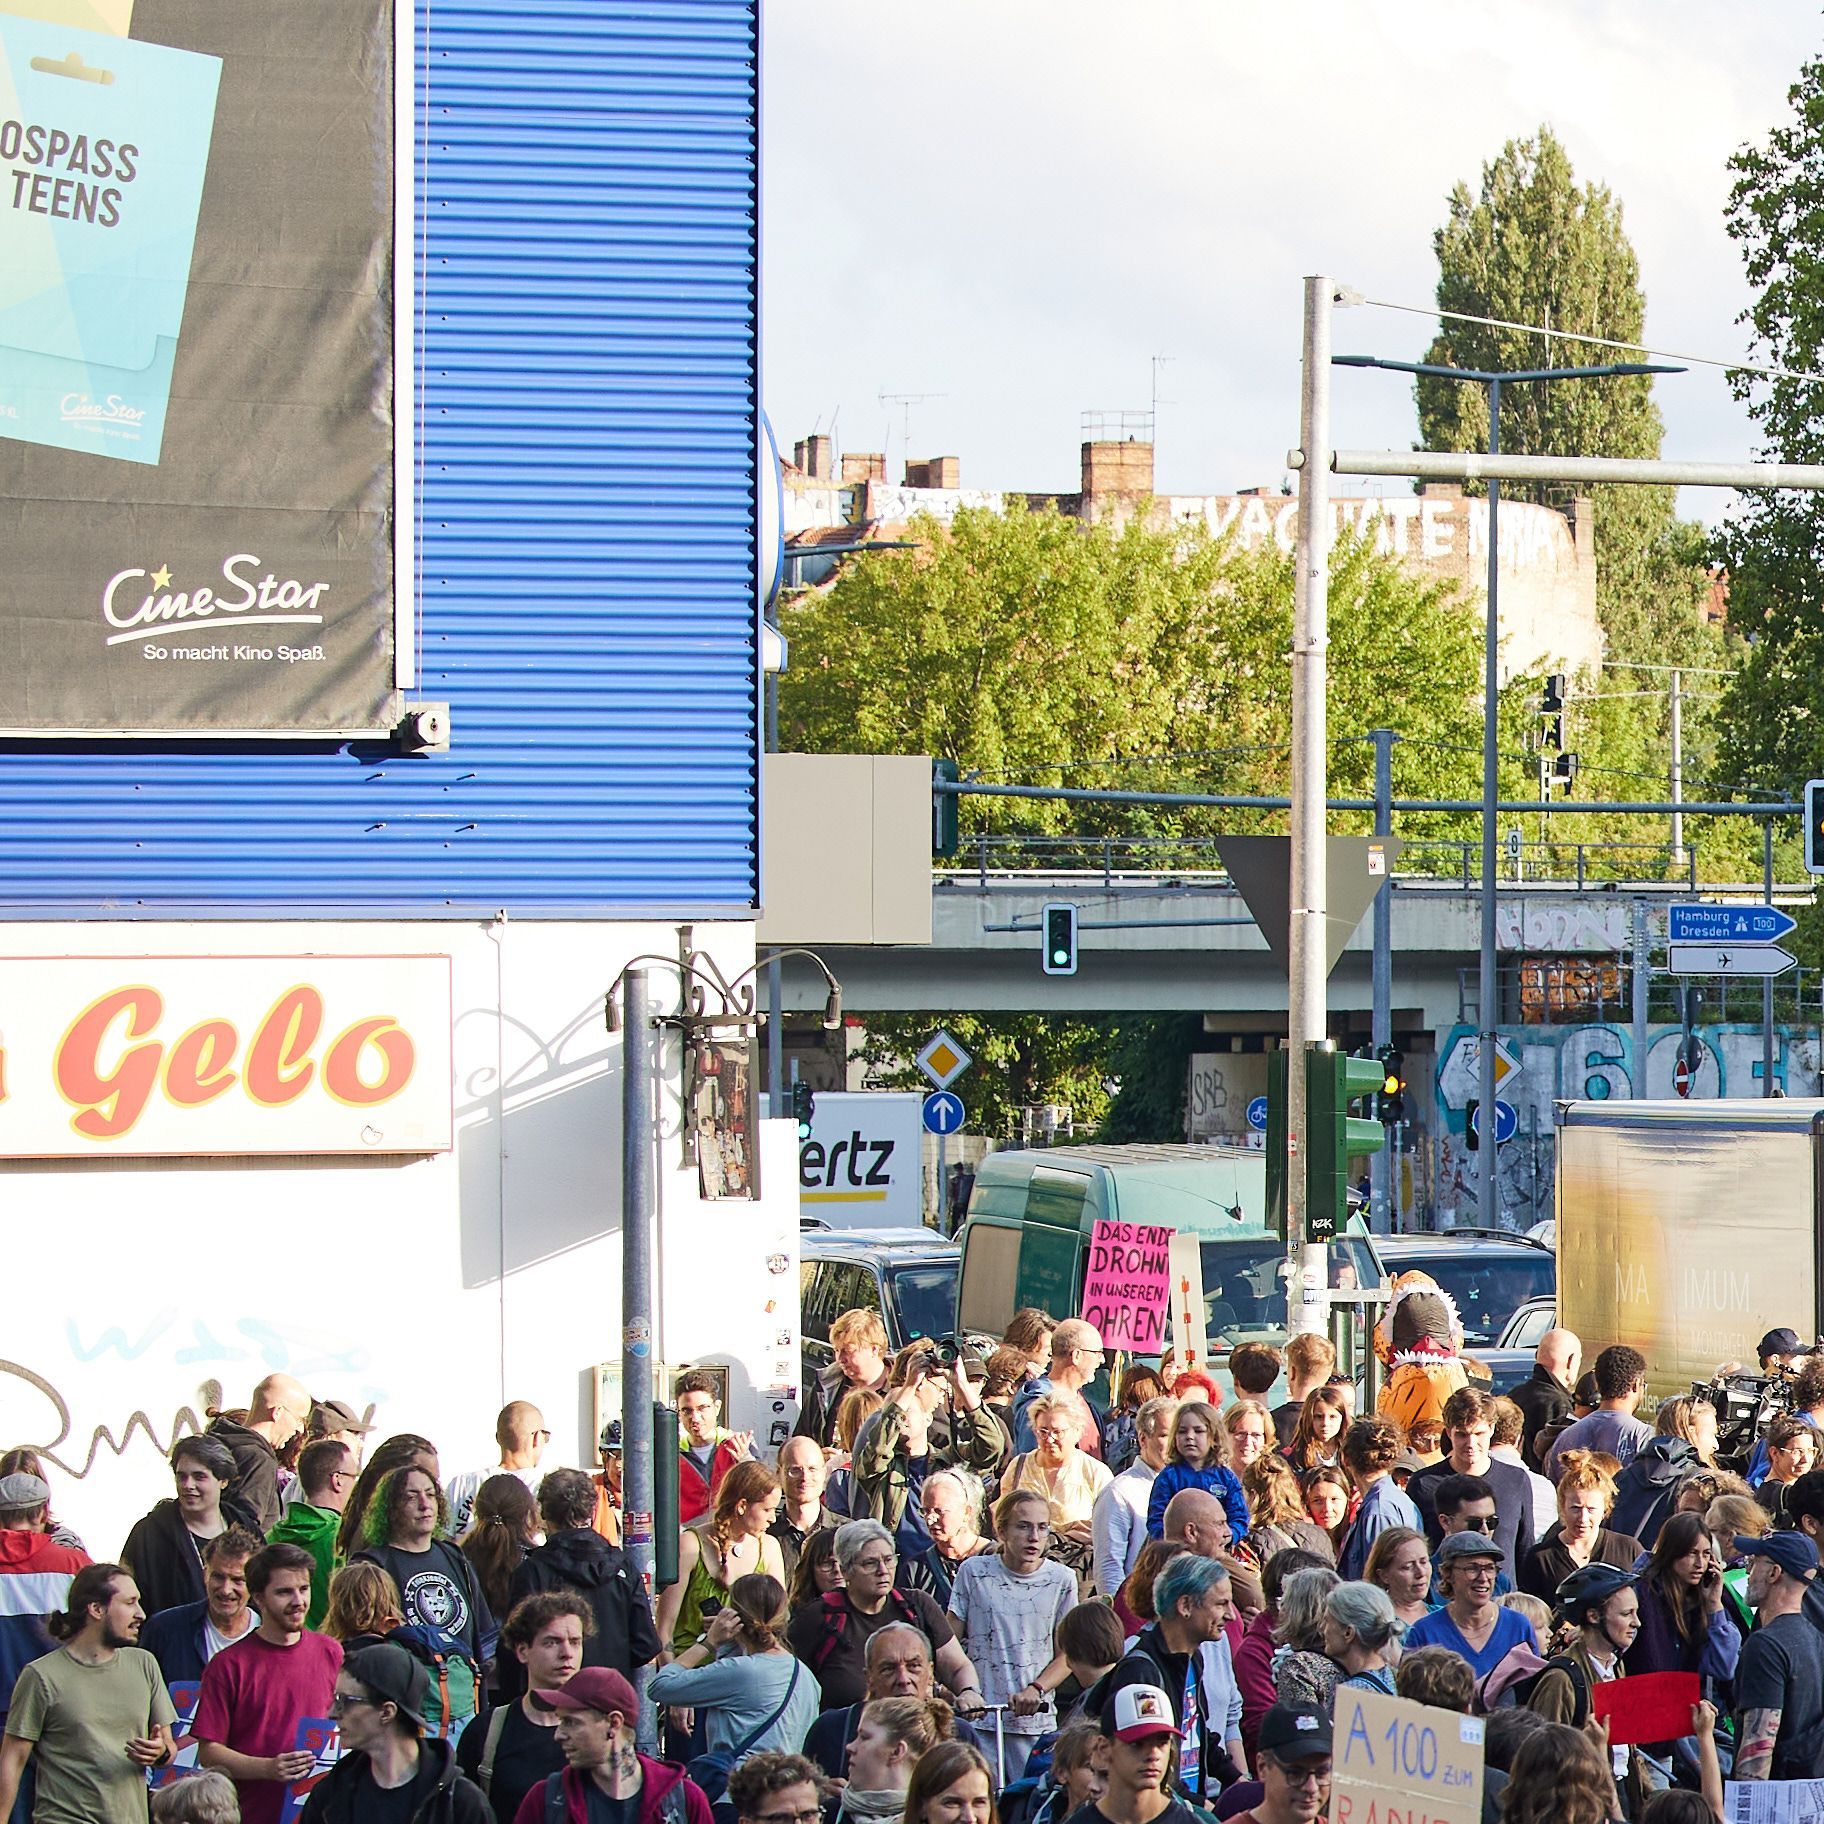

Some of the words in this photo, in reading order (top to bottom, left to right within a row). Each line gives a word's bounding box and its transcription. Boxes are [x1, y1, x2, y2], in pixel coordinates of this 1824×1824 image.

[12, 169, 122, 228] TEENS
[60, 393, 146, 420] CineStar
[103, 553, 330, 628] CineStar
[144, 644, 168, 660] So
[172, 645, 229, 660] macht
[234, 646, 273, 661] Kino
[277, 646, 326, 663] Spaß.
[1676, 910, 1730, 925] Hamburg
[1680, 925, 1730, 937] Dresden
[1757, 919, 1772, 928] 100
[52, 983, 417, 1141] Gelo
[800, 1130, 895, 1187] ertz
[1097, 1222, 1132, 1242] DAS
[1090, 1282, 1104, 1297] IN
[1105, 1282, 1164, 1301] UNSEREN
[1086, 1305, 1164, 1342] OHREN
[1344, 1702, 1375, 1767] A
[1385, 1717, 1438, 1781] 100
[1443, 1766, 1473, 1788] ZUM
